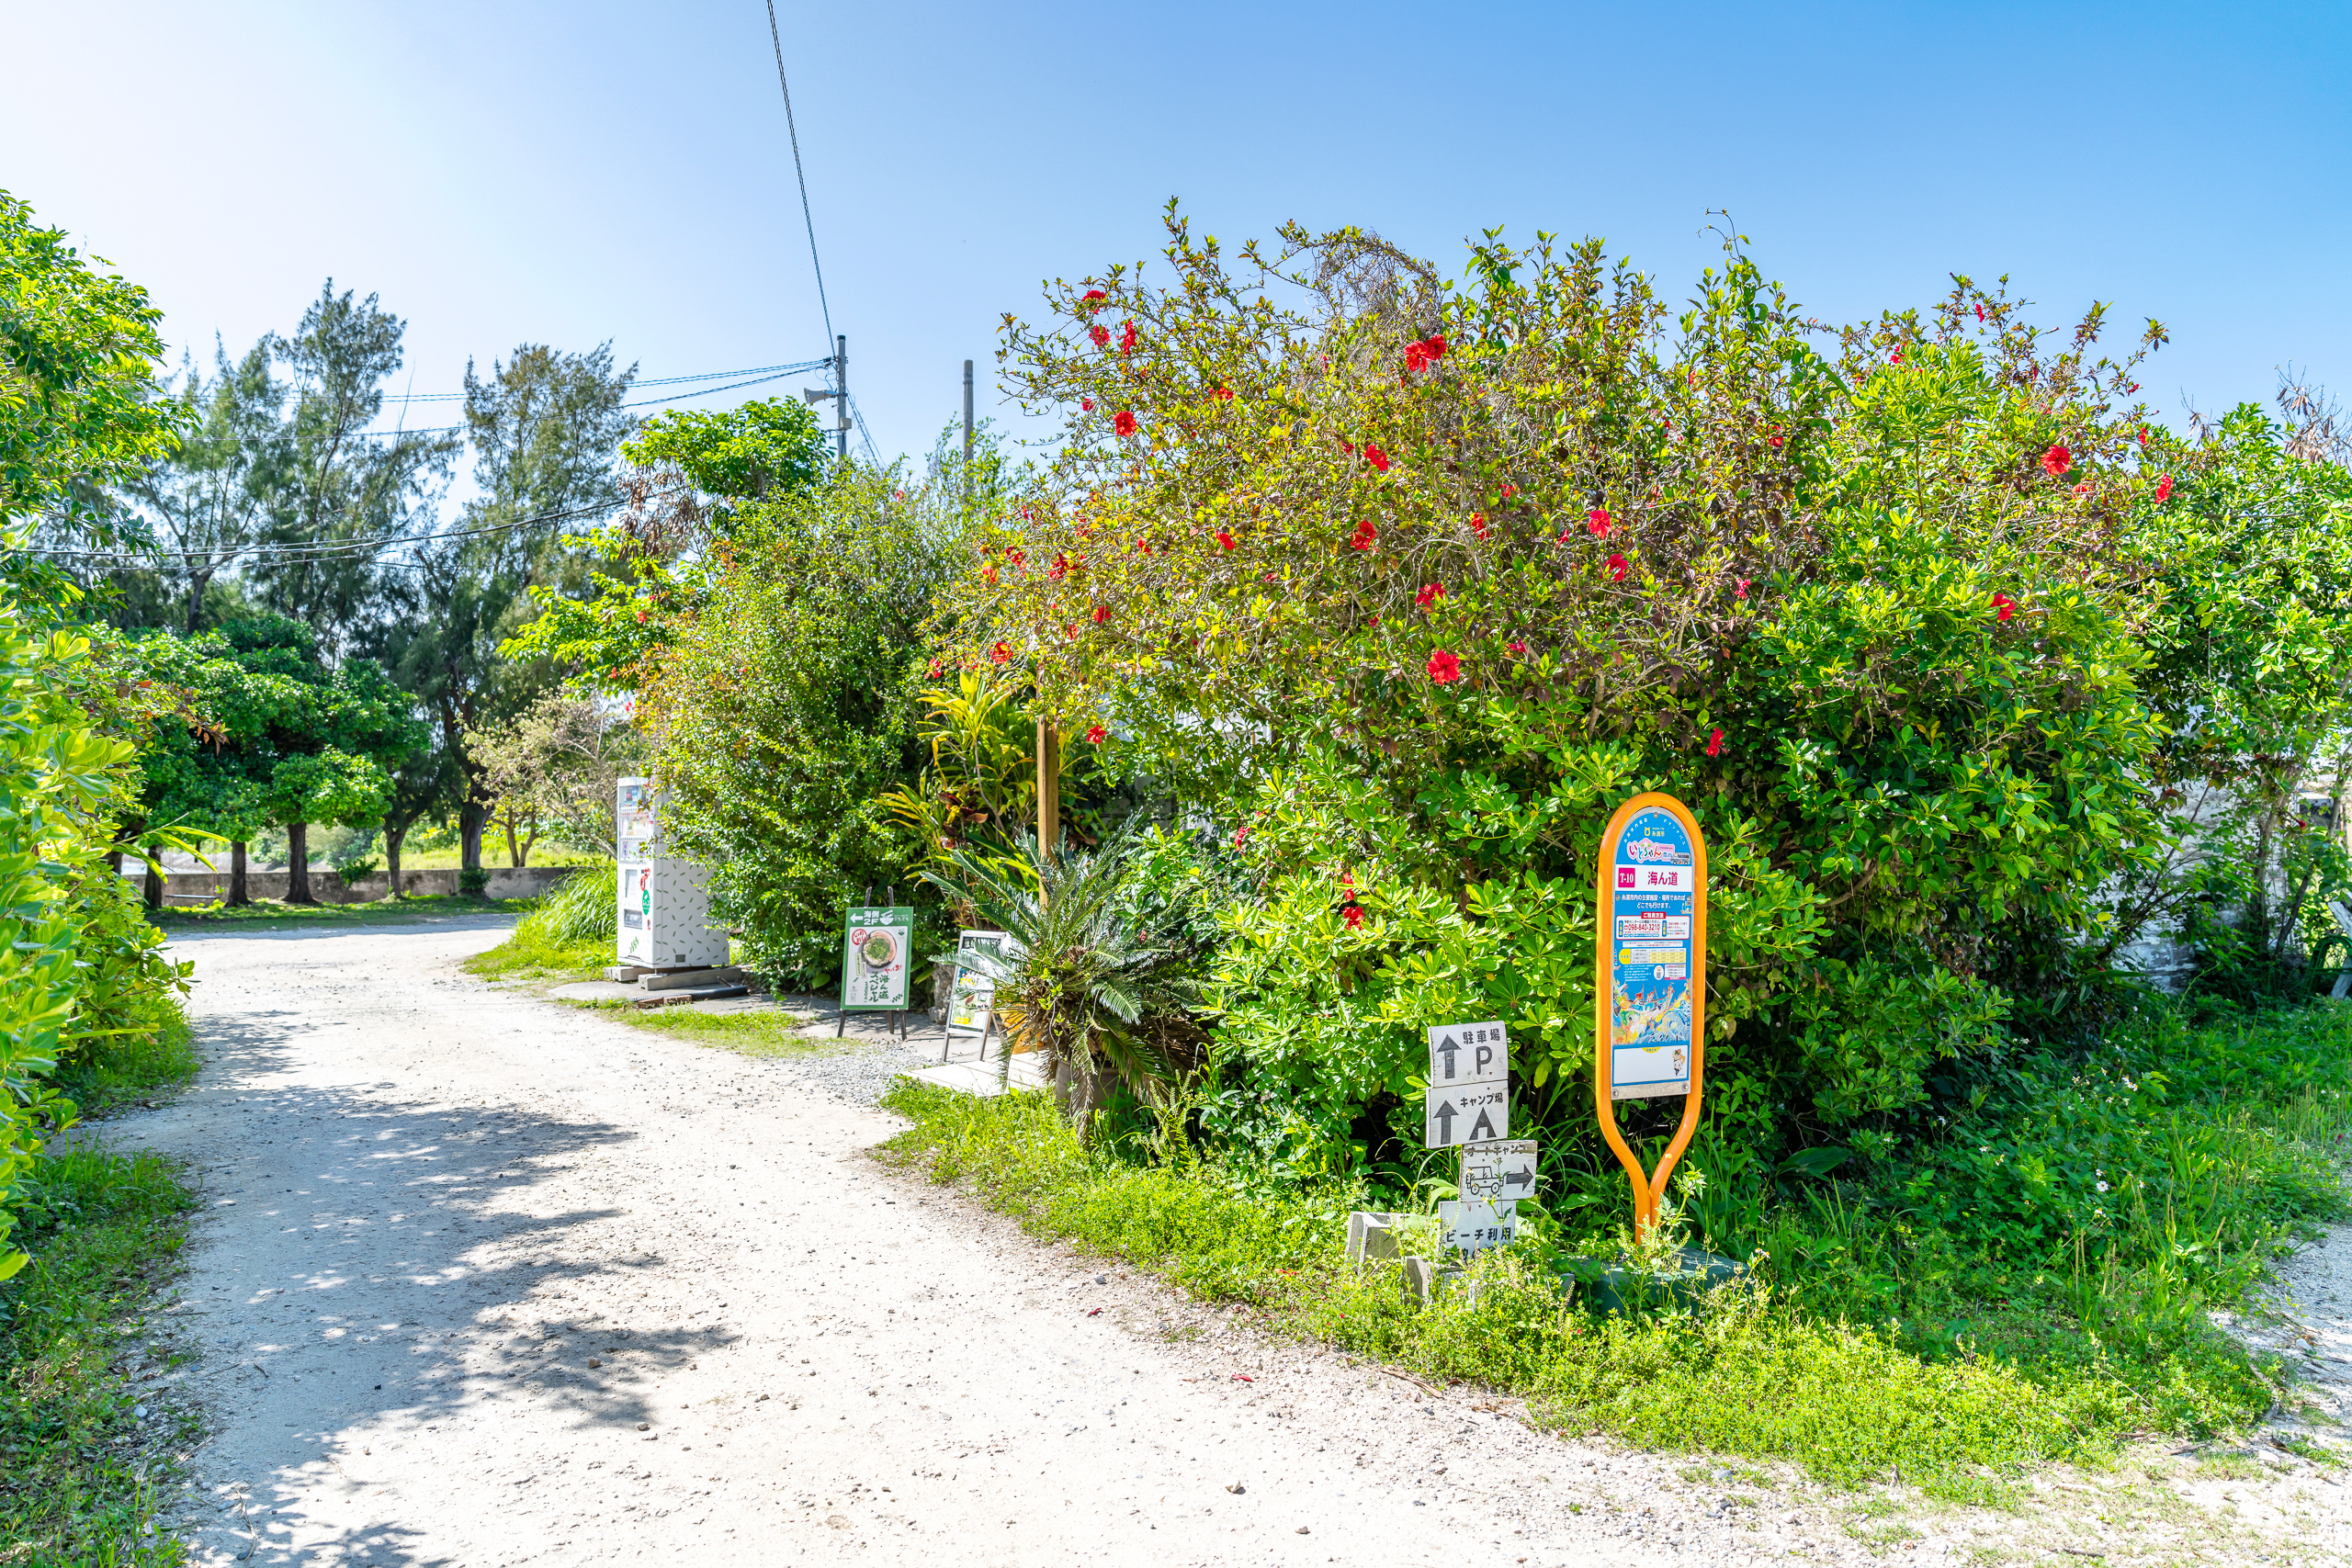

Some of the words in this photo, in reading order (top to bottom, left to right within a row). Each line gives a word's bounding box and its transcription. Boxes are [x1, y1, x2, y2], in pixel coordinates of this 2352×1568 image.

[1629, 844, 1662, 860] いとちゃん
[1647, 871, 1679, 886] 海ん道
[869, 971, 879, 1002] スペシャル
[1463, 1028, 1500, 1044] 駐車場
[1476, 1045, 1492, 1075] P
[1460, 1092, 1504, 1108] キャンプ場
[1447, 1227, 1511, 1242] ビーチ利用
